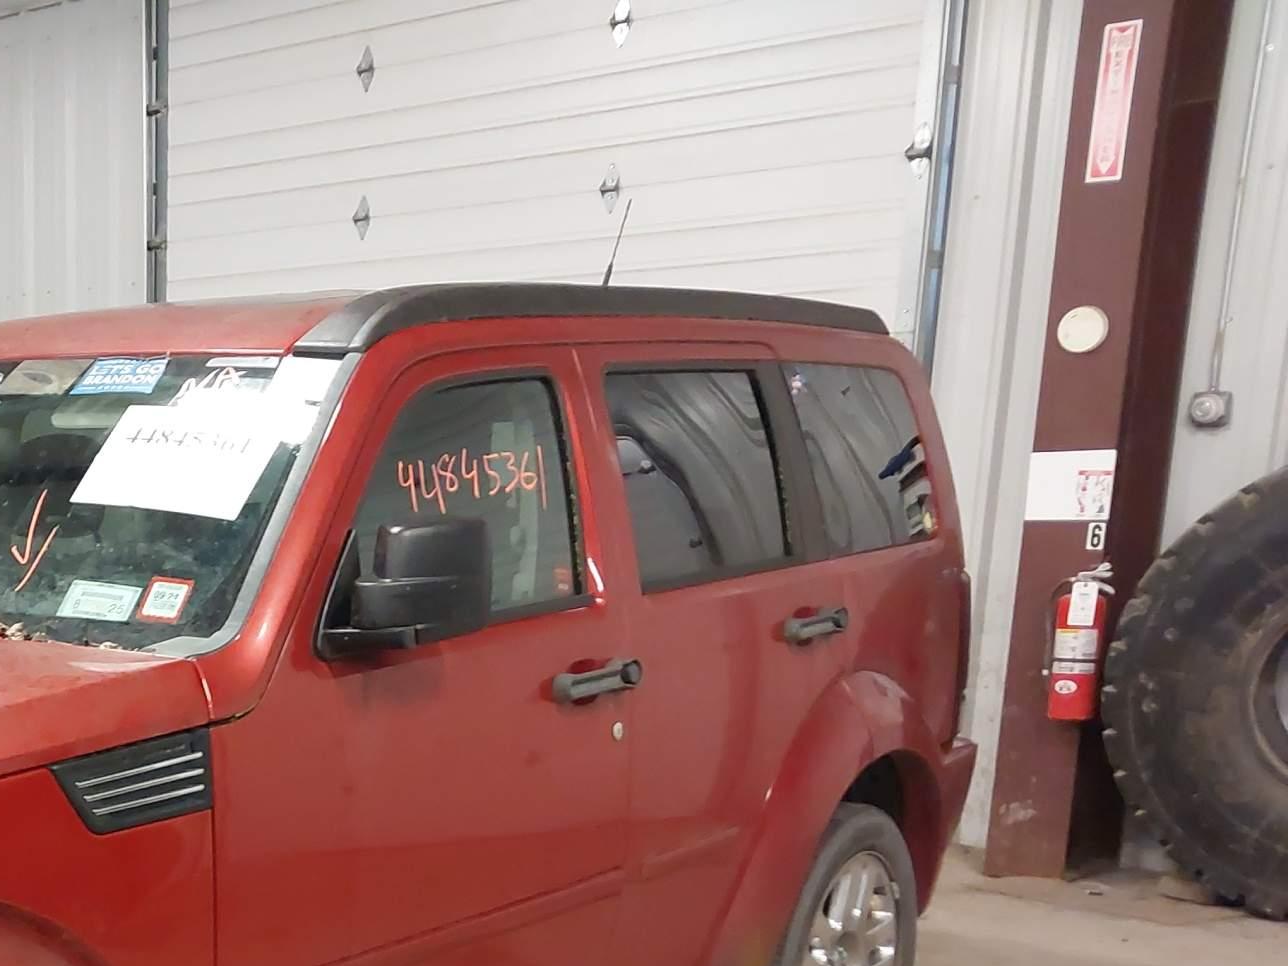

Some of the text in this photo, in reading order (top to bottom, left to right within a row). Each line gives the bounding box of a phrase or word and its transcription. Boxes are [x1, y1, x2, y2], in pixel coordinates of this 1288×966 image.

[88, 364, 165, 375] LET'S GO
[81, 374, 158, 385] BRANDON
[397, 444, 548, 515] 44845361
[1090, 524, 1103, 548] 6
[107, 602, 125, 615] 25
